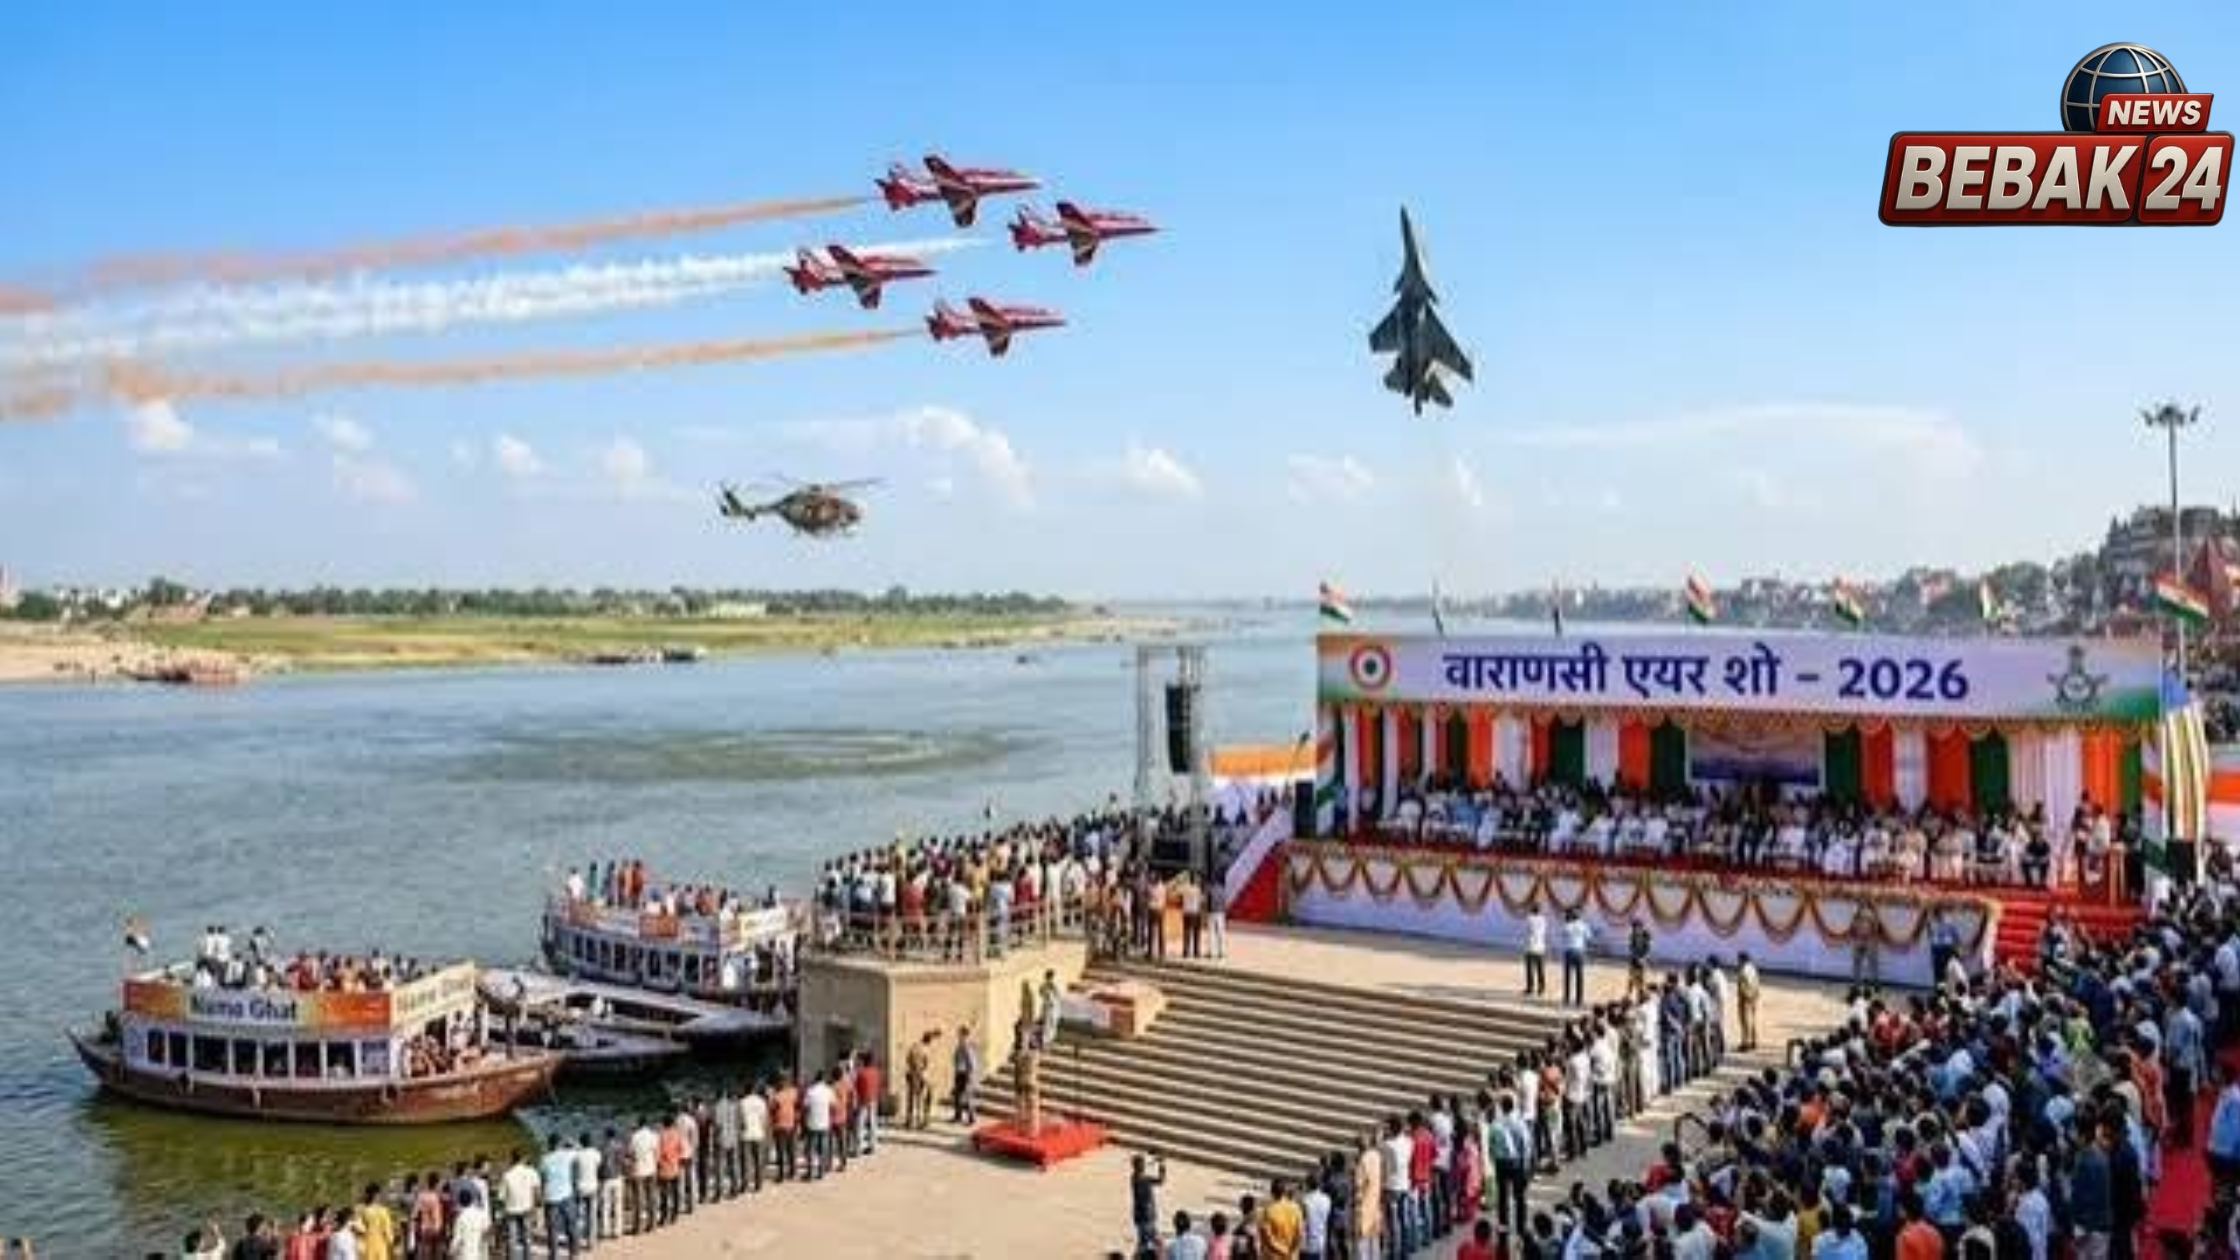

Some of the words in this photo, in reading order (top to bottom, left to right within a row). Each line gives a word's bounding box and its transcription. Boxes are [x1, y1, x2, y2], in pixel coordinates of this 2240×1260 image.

[1443, 642, 1609, 692] वाराणसी
[1622, 656, 1709, 699] एयर
[1723, 641, 1781, 695] शो
[1838, 657, 1969, 701] 2026
